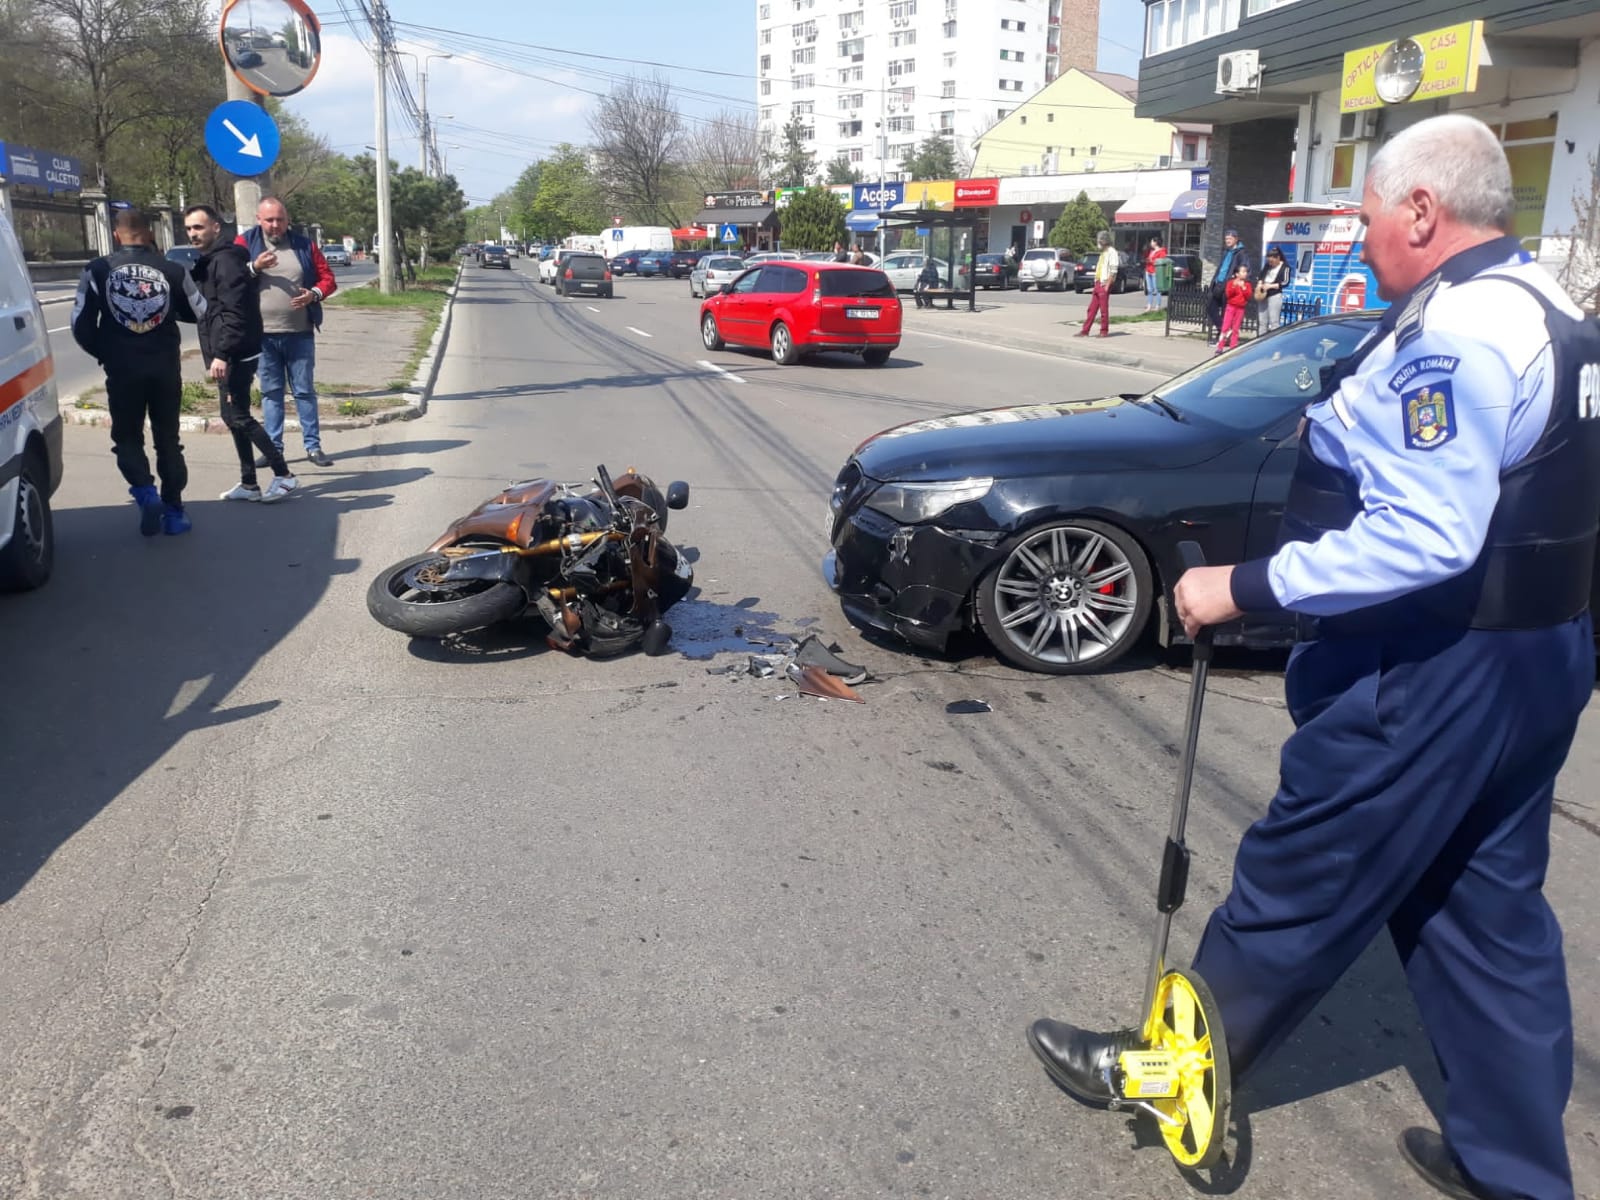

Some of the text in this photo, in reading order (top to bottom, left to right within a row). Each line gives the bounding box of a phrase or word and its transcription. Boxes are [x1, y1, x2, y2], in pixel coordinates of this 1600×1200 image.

[1430, 31, 1457, 51] CASA
[1346, 50, 1380, 88] OPTICA
[53, 157, 71, 172] CLUB
[46, 170, 80, 187] CALCETTO
[860, 187, 897, 203] Acces
[1285, 221, 1311, 236] eMAG
[1578, 362, 1600, 419] PO
